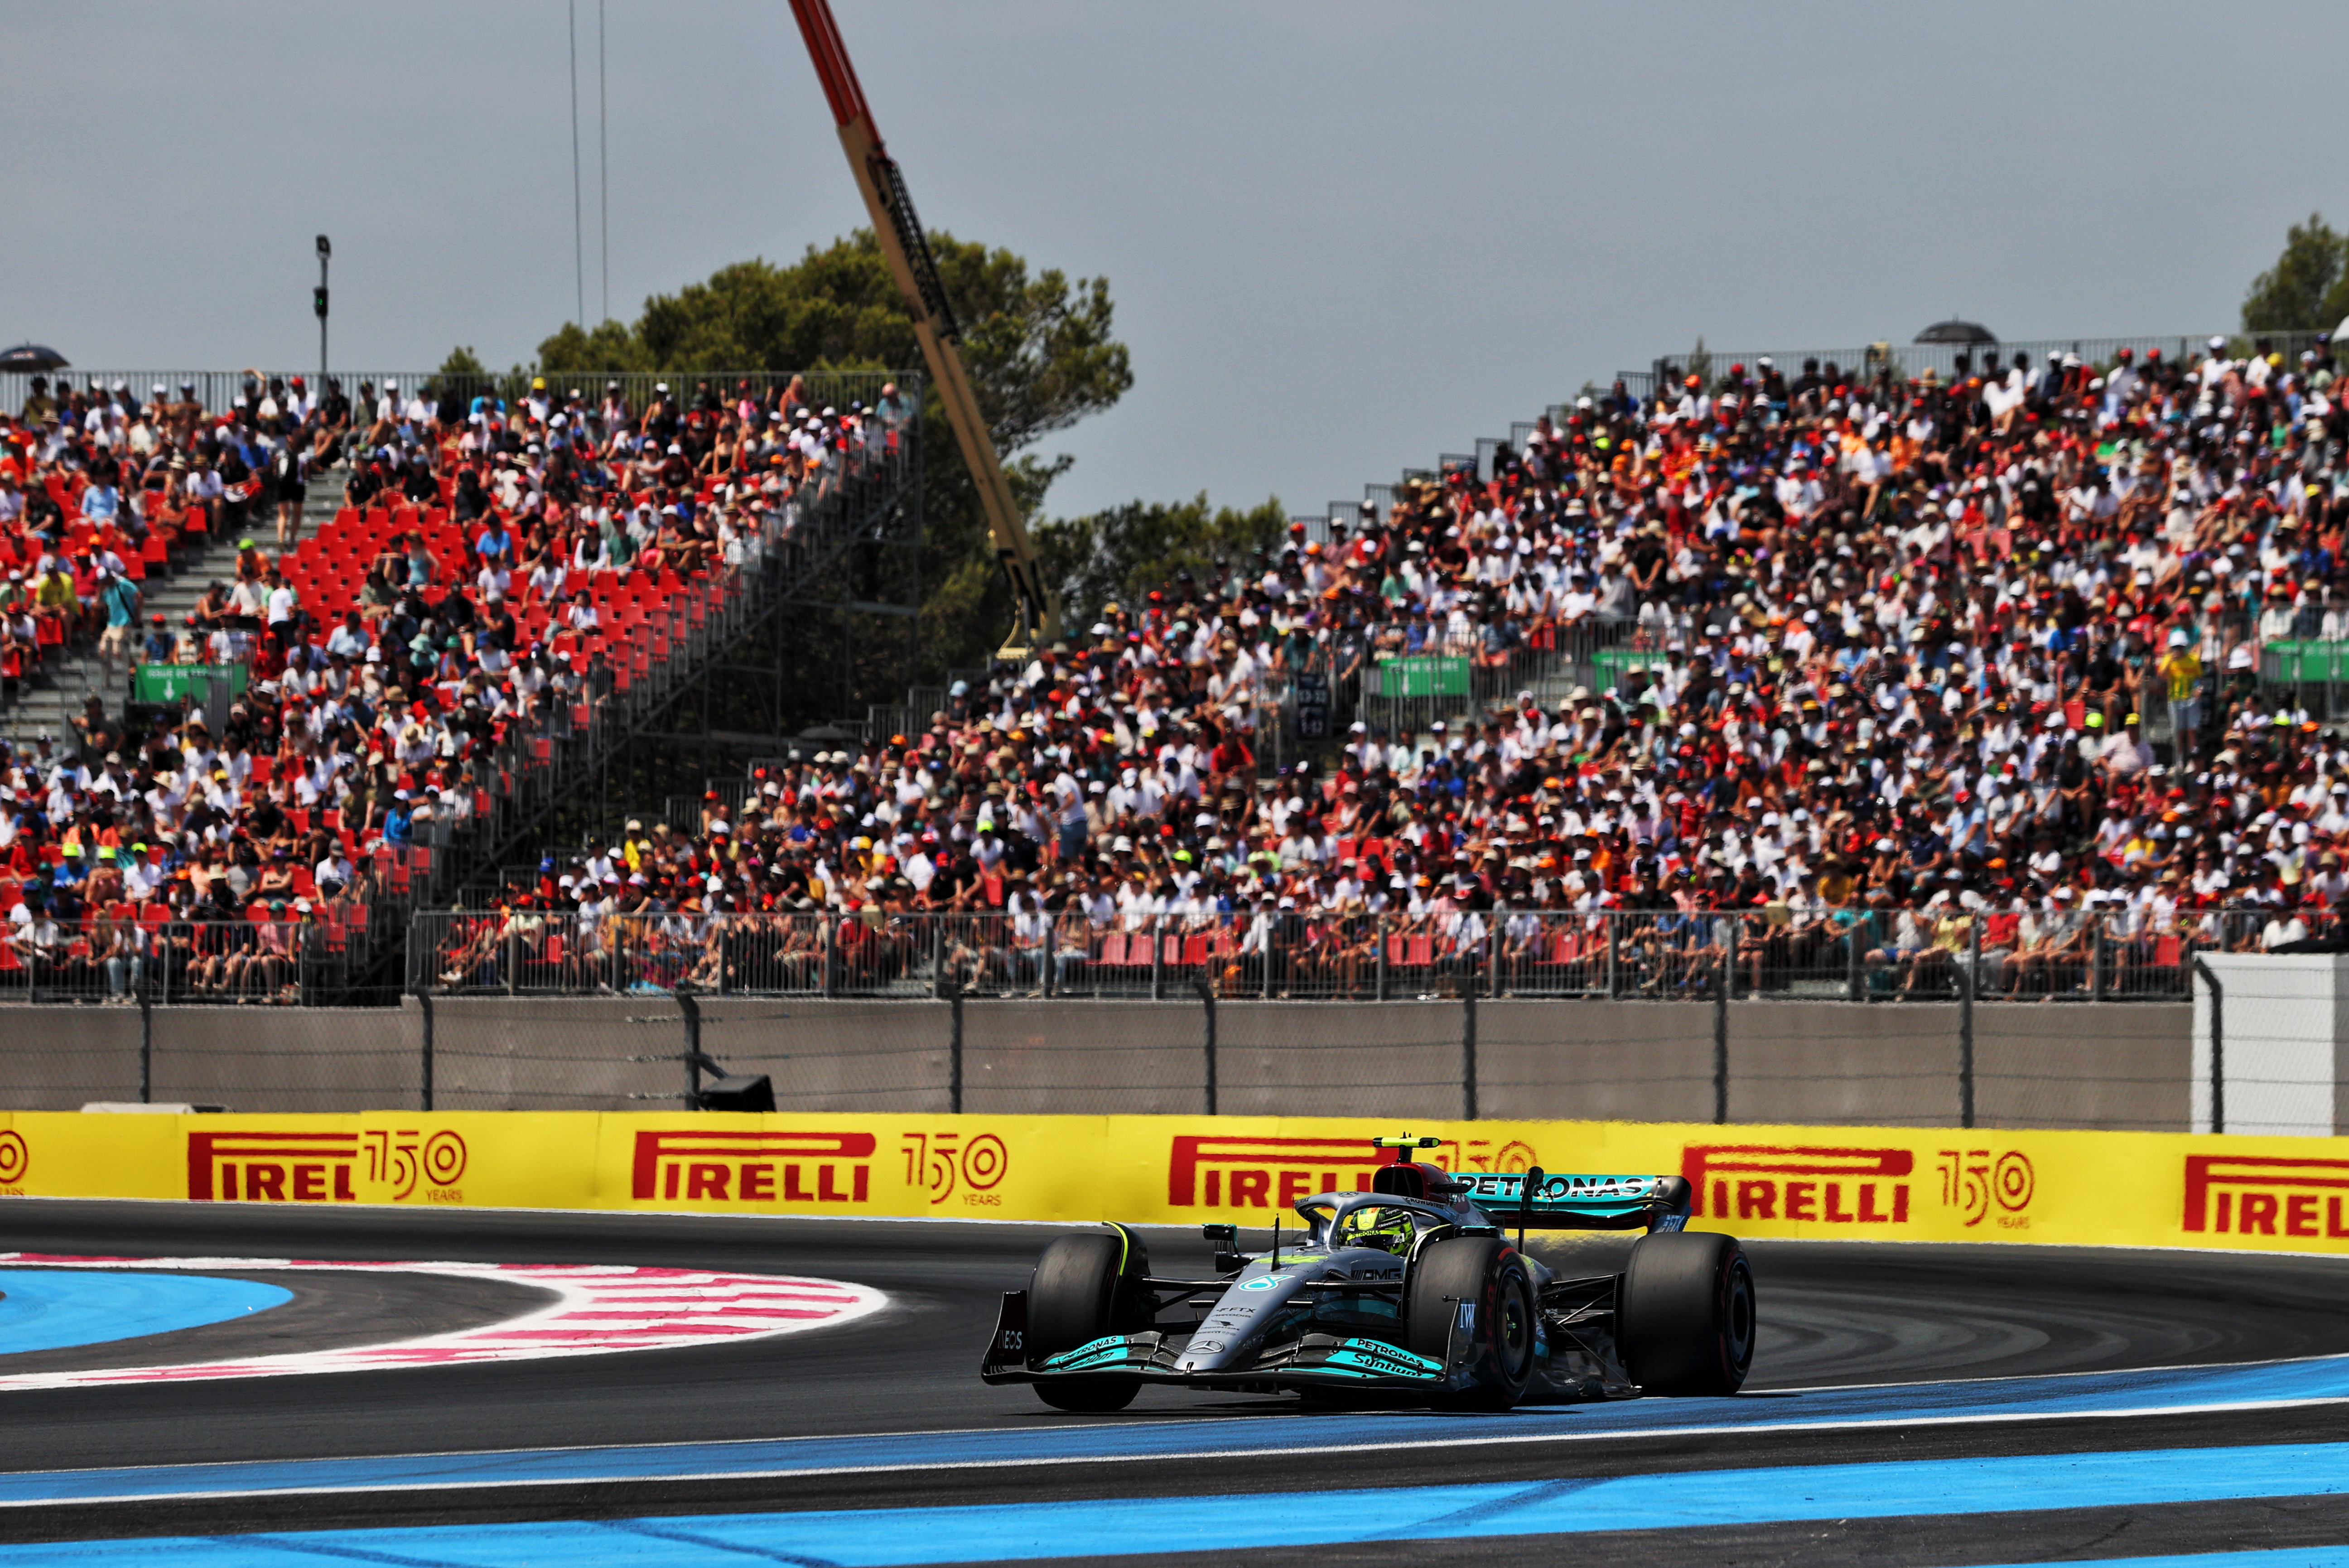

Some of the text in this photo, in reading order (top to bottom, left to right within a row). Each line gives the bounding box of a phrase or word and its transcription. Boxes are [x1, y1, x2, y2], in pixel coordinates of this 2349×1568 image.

[364, 1130, 467, 1201] 150
[632, 1130, 1008, 1204] PIRELLI 150
[425, 1189, 463, 1202] YEARS
[1681, 1143, 2035, 1227] PIRELLI 150
[962, 1194, 1002, 1206] YEARS
[1405, 1197, 1445, 1210] CROWDSTRIKE
[1996, 1216, 2031, 1230] YEARS
[998, 1329, 1023, 1350] INEOS
[1062, 1336, 1118, 1361] PETRONAS
[1357, 1339, 1424, 1365] PETRONAS
